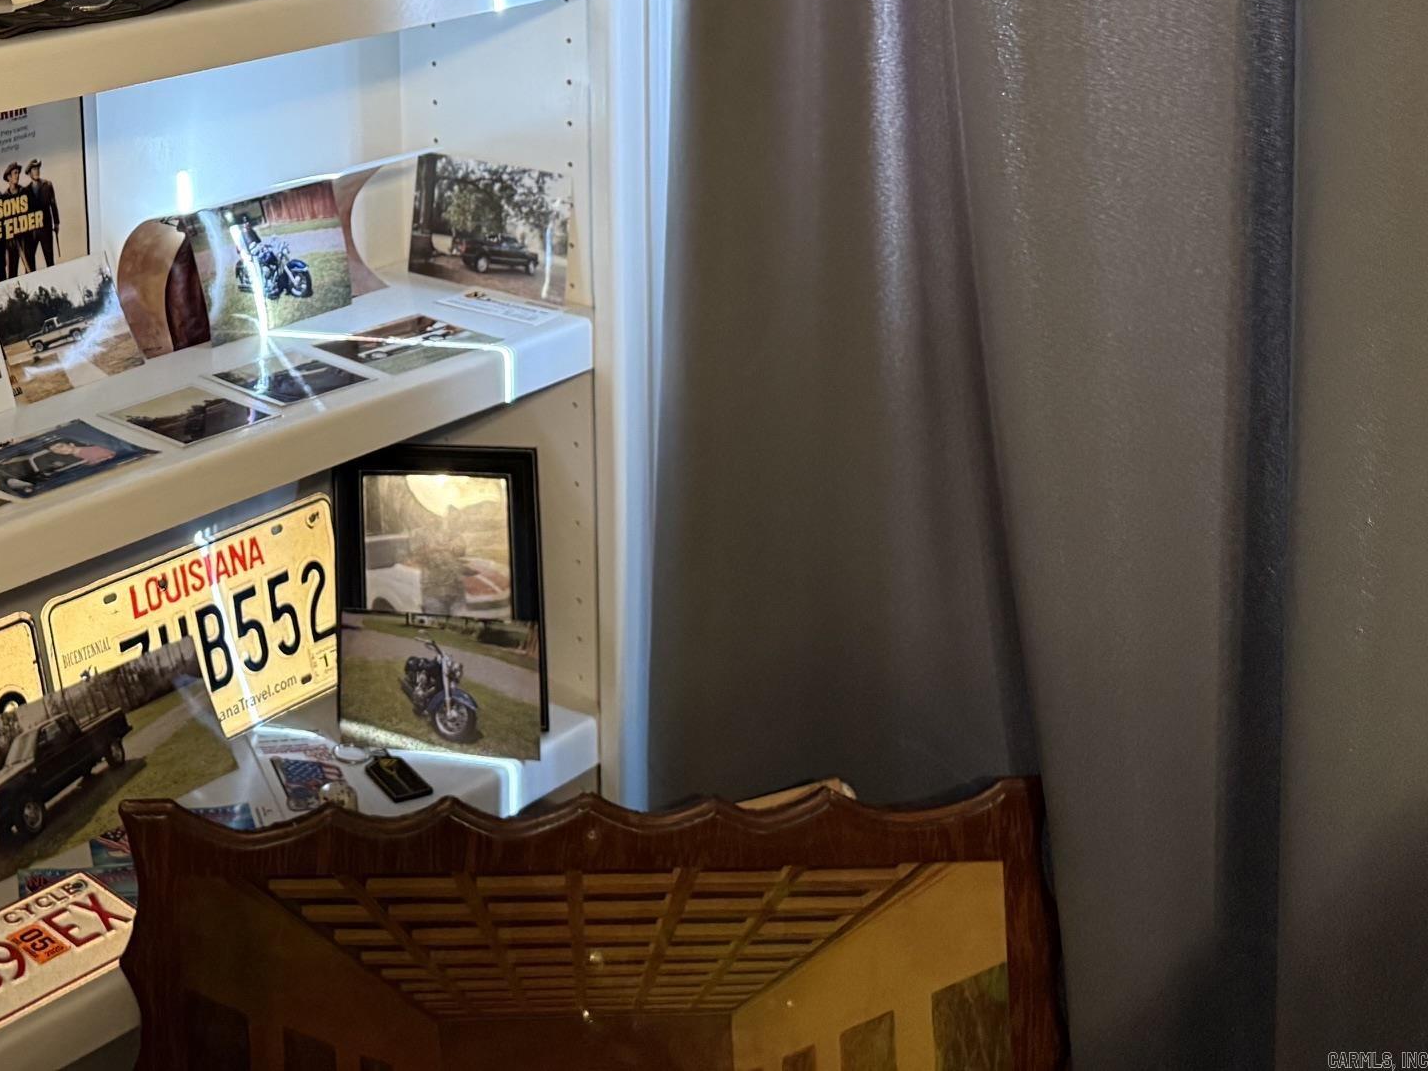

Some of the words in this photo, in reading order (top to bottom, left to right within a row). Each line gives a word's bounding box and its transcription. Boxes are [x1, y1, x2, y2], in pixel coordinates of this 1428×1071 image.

[4, 210, 44, 240] ELDER
[128, 536, 265, 619] LOUISIANA
[61, 637, 111, 669] BICENTENNIAL
[3, 882, 80, 924] CYCLE
[42, 892, 133, 948] EX
[19, 928, 55, 951] 05
